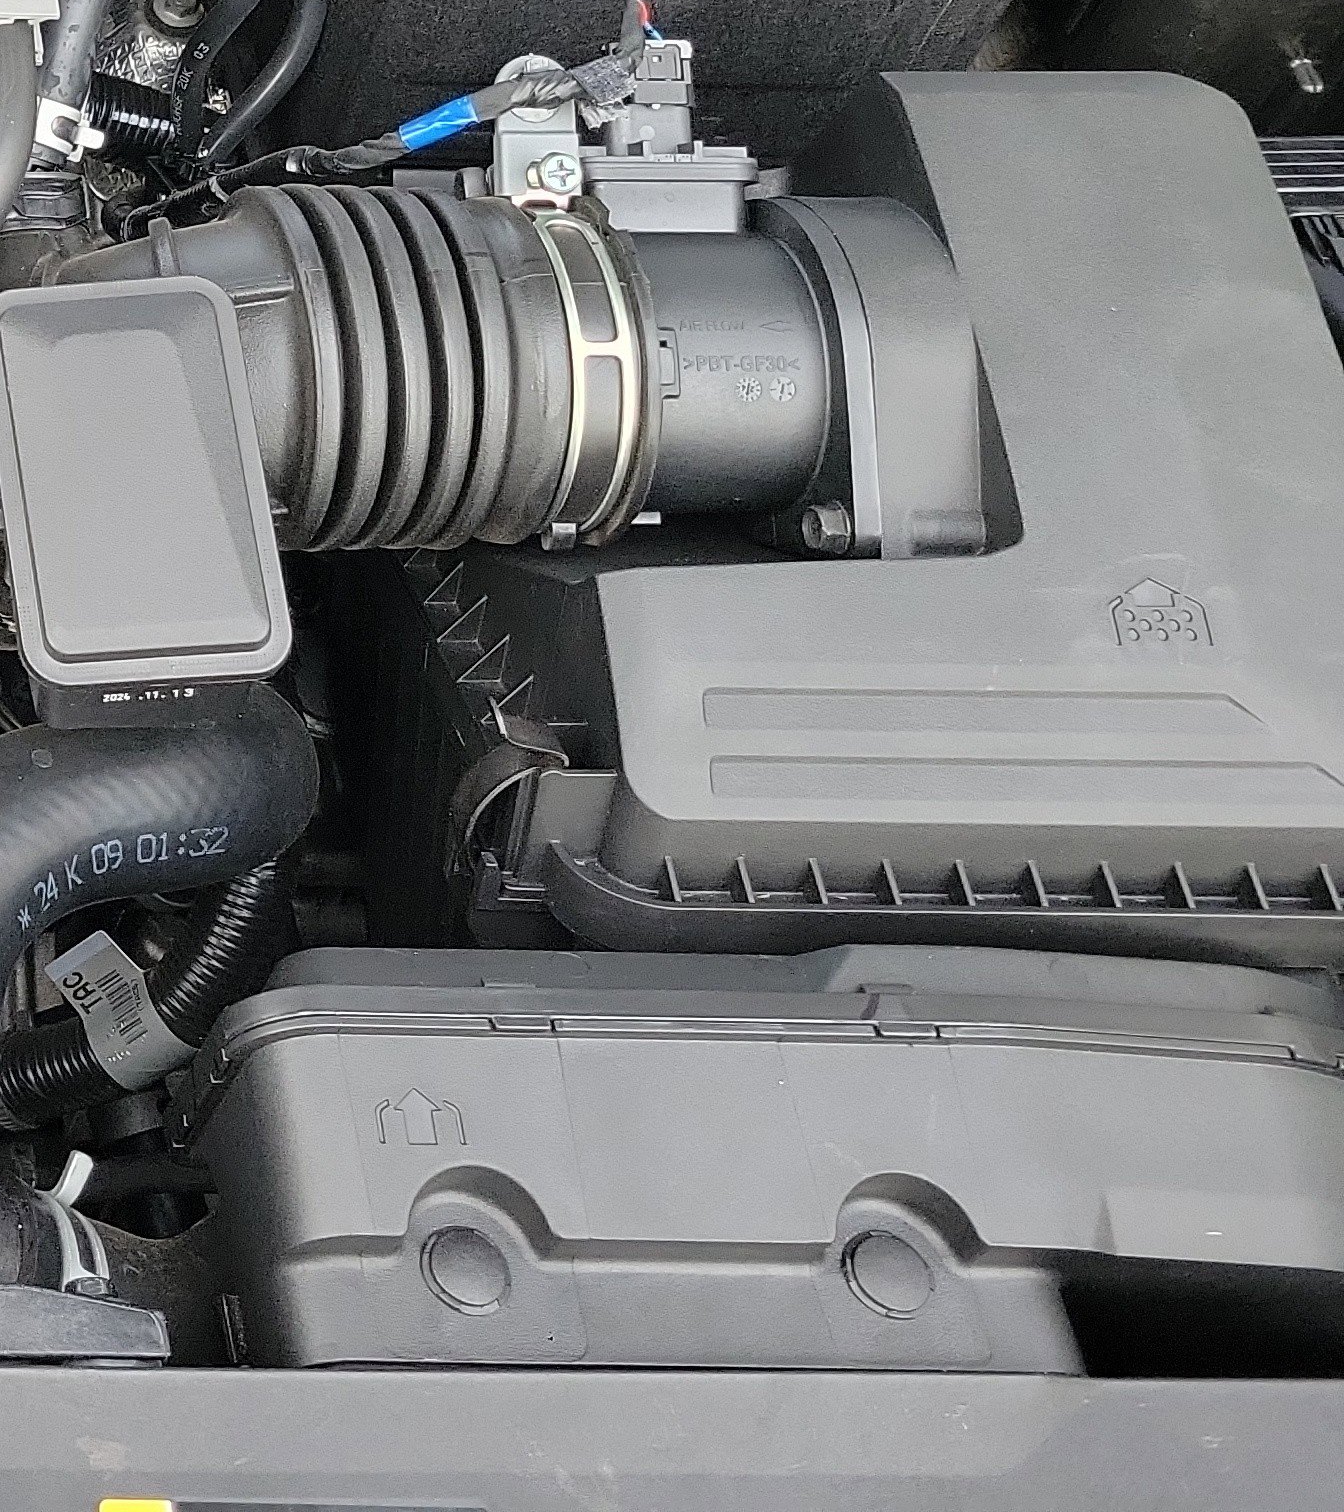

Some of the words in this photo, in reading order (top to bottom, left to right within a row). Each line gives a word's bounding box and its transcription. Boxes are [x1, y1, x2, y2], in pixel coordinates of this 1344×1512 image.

[34, 871, 59, 914] 24
[64, 854, 84, 891] K
[90, 838, 124, 875] 09
[62, 971, 104, 1015] TAC
